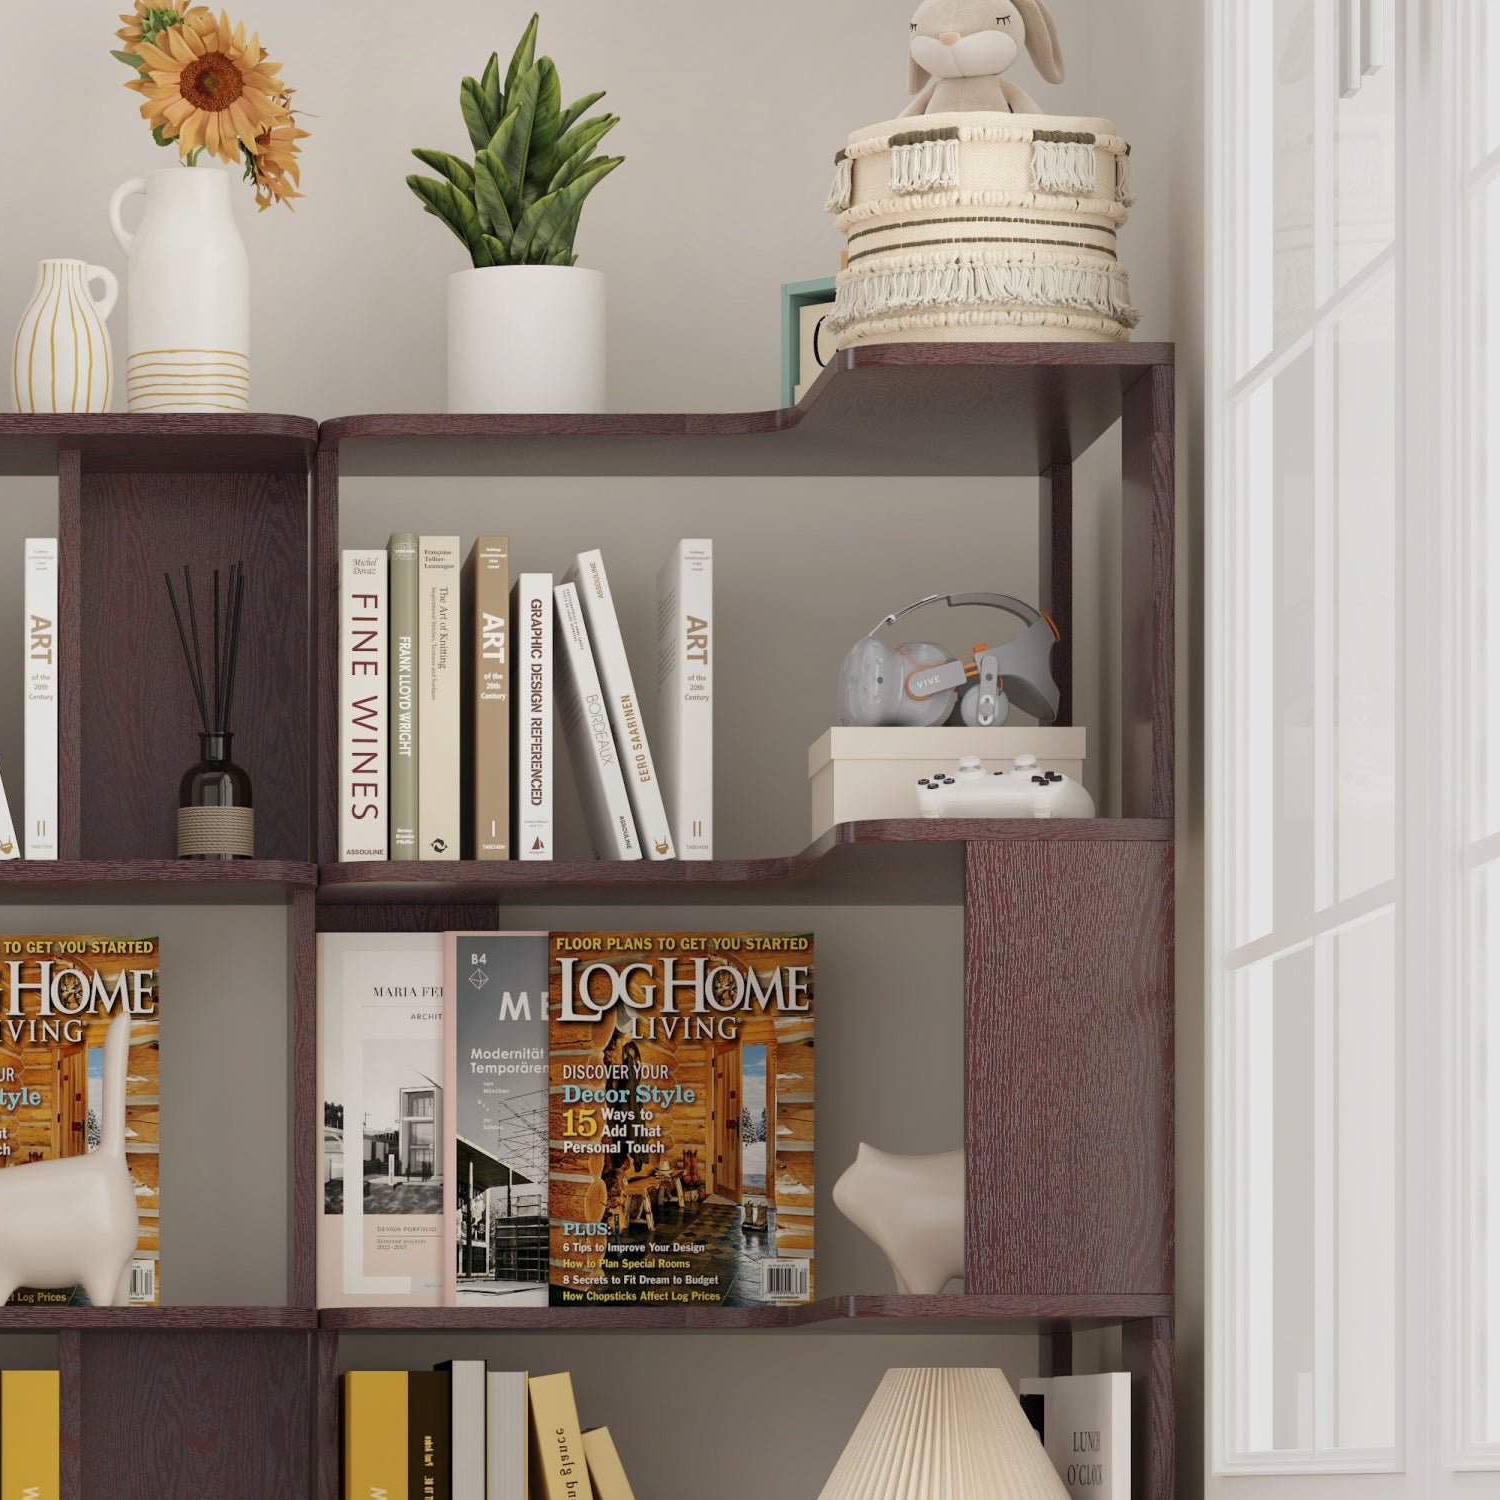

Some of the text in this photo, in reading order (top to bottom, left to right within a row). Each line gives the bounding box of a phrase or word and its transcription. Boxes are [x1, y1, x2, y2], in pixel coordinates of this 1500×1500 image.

[530, 598, 543, 659] GRAPHIC
[686, 614, 709, 665] ART
[687, 674, 707, 682] of the
[916, 674, 941, 688] VIVE
[530, 663, 543, 713] DESIGN
[689, 683, 705, 691] 20th
[684, 693, 710, 703] Century
[351, 593, 379, 820] FINE WINES
[620, 694, 651, 783] EERO SAARINEN
[530, 716, 543, 807] REFERENCED
[3, 941, 22, 954] TO
[26, 941, 54, 954] GET
[59, 941, 87, 954] YOU
[91, 941, 154, 954] STARTED
[555, 937, 809, 951] FLOOR PLANS TO GET YOU STARTED
[471, 953, 487, 965] B4
[629, 1016, 738, 1040] LIVING
[470, 1047, 546, 1060] Modernität
[562, 1064, 669, 1080] DISCOVER YOUR
[561, 1084, 696, 1109] Decor Style
[600, 1107, 654, 1122] Ways to
[562, 1109, 598, 1138] 15
[600, 1124, 662, 1138] Add That
[562, 1140, 665, 1154] Personal Touch
[562, 1222, 613, 1237] PLUS:
[562, 1242, 706, 1254] 6 Tips to Improve Your Design
[562, 1258, 692, 1270] How to Plan Special Rooms
[562, 1274, 720, 1286] 8 Secrets to Fit Dream to Budget
[562, 1290, 722, 1303] How Chopsticks Affect Log Prices
